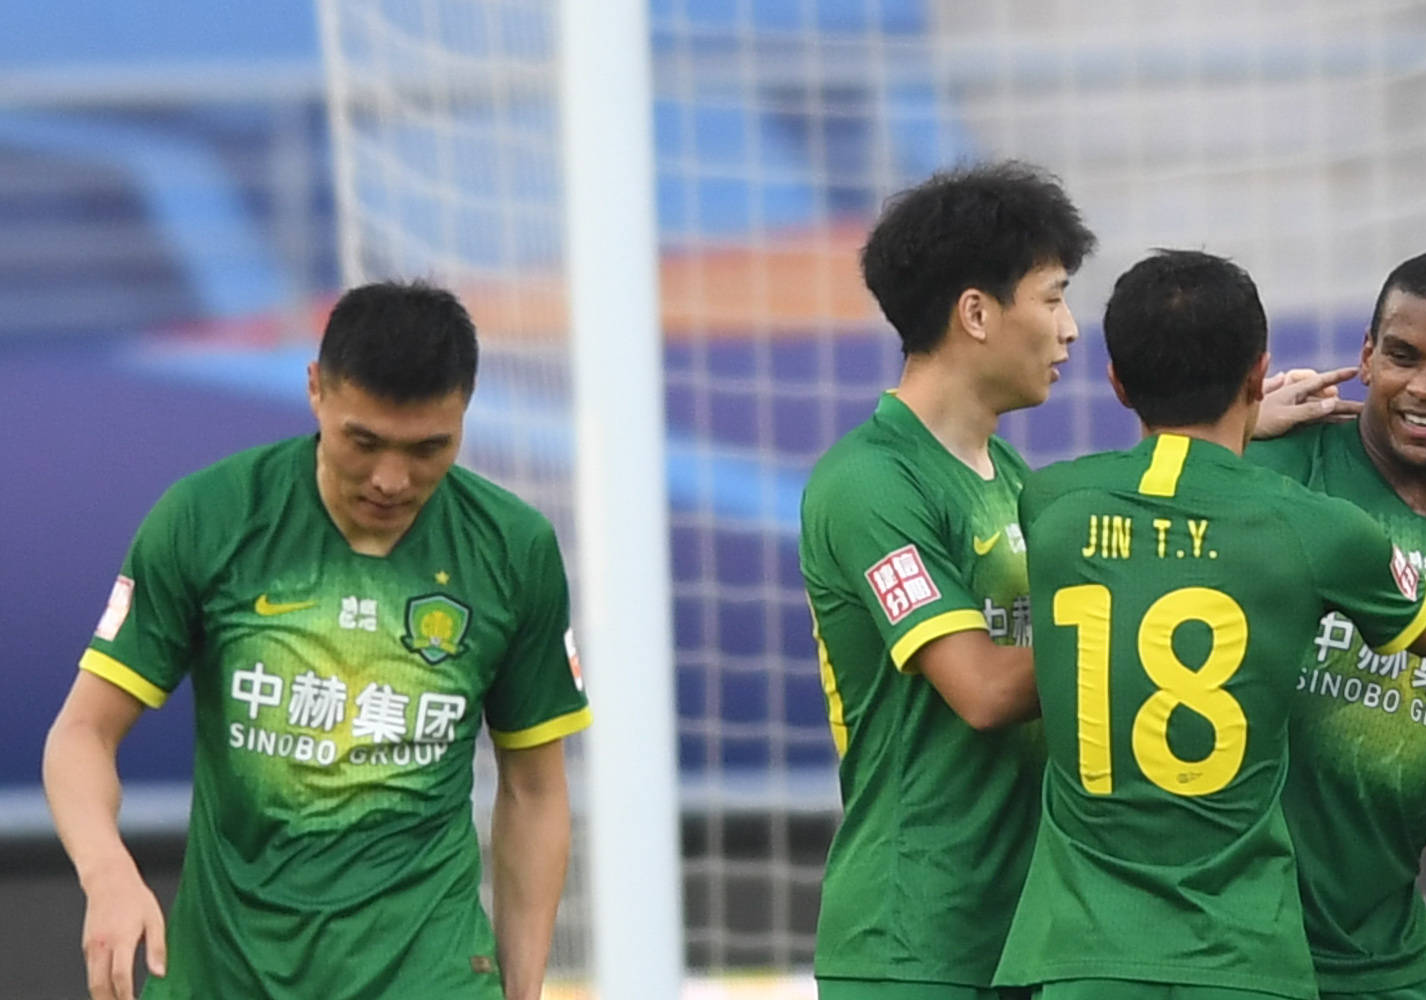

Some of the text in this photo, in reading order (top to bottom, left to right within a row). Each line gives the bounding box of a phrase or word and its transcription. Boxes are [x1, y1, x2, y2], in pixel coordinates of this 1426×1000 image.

[1082, 515, 1217, 558] JIN T.Y.
[231, 662, 467, 743] 中赫集团
[1053, 584, 1248, 796] 18
[1297, 667, 1400, 713] SINOBO
[229, 723, 448, 766] SINOBO GROUP
